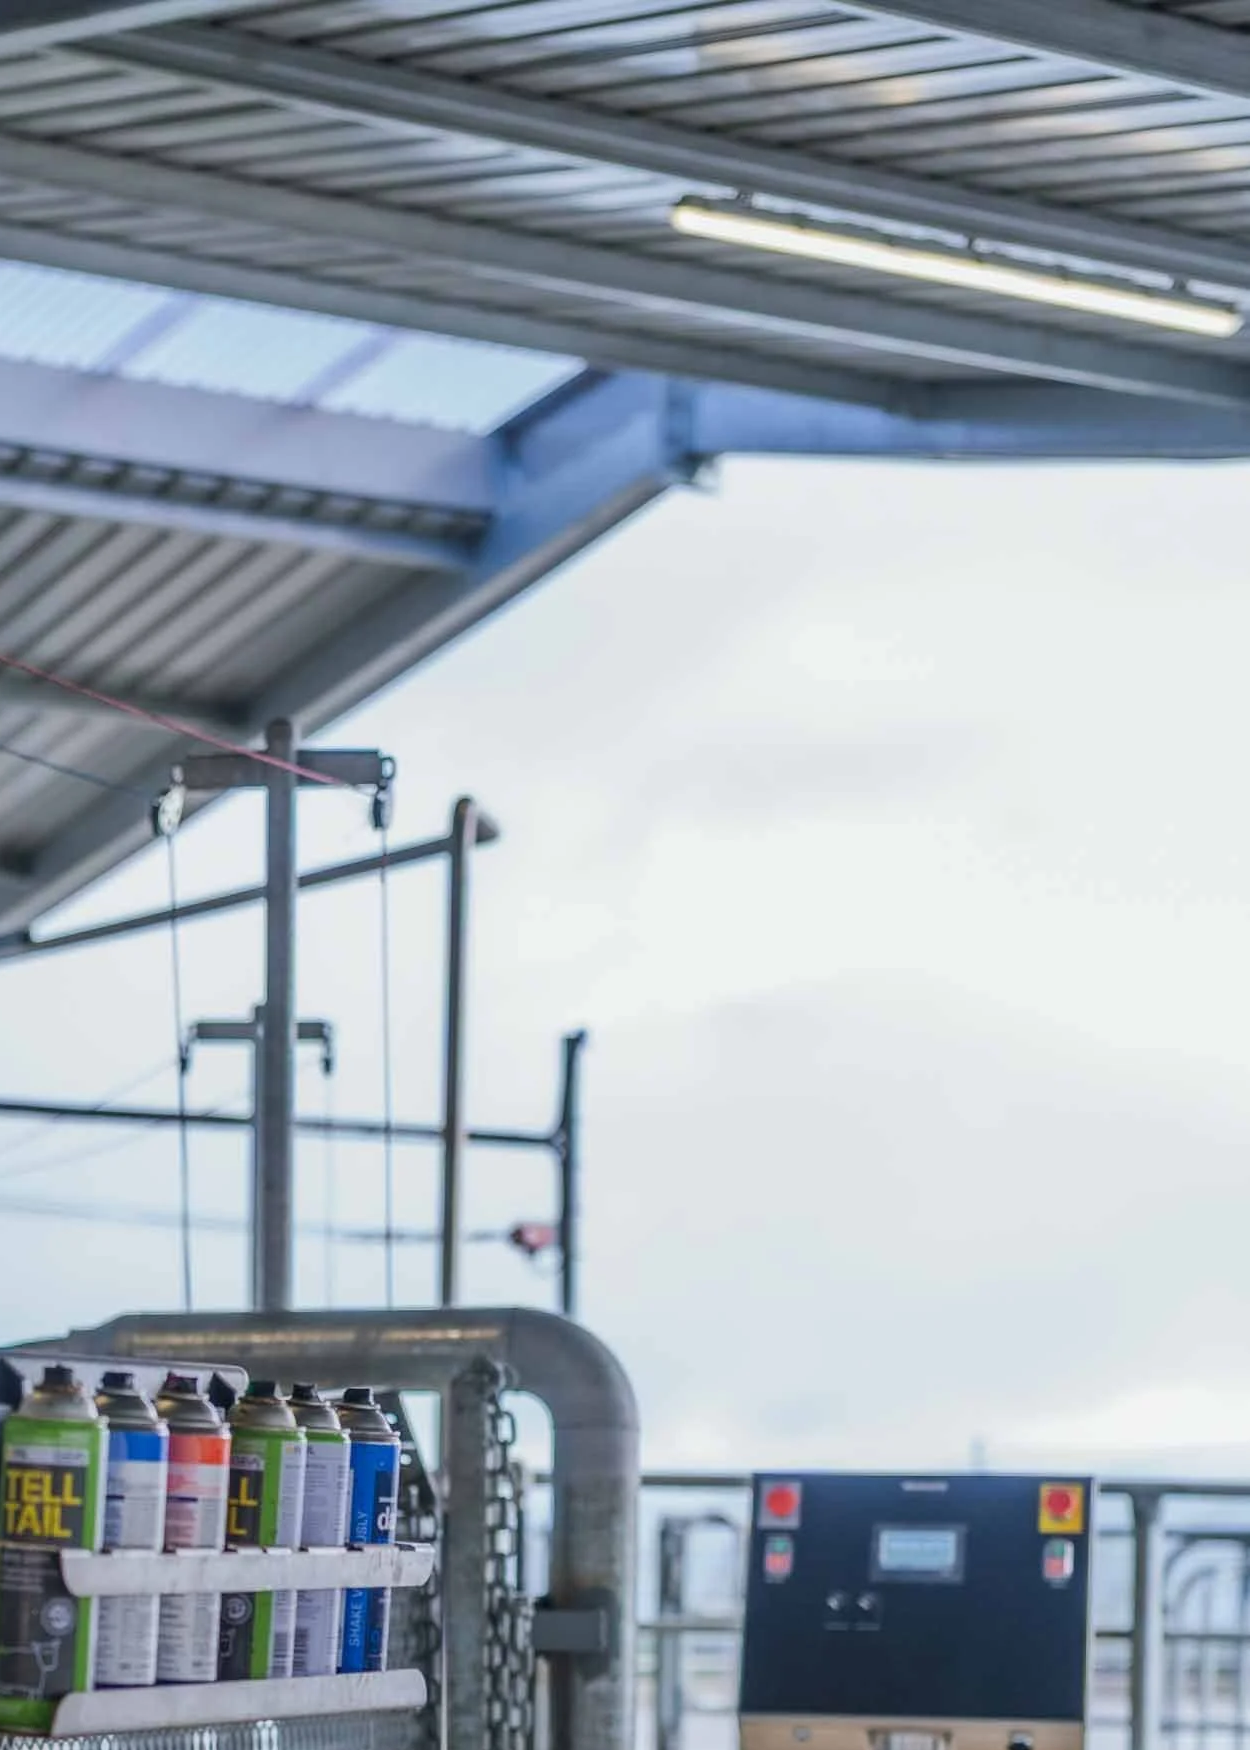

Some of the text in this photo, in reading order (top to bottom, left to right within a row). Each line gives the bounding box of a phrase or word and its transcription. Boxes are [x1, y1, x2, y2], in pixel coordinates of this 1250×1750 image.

[6, 1469, 83, 1506] TELL
[3, 1503, 73, 1538] TAIL
[348, 1600, 365, 1647] SHAKE
